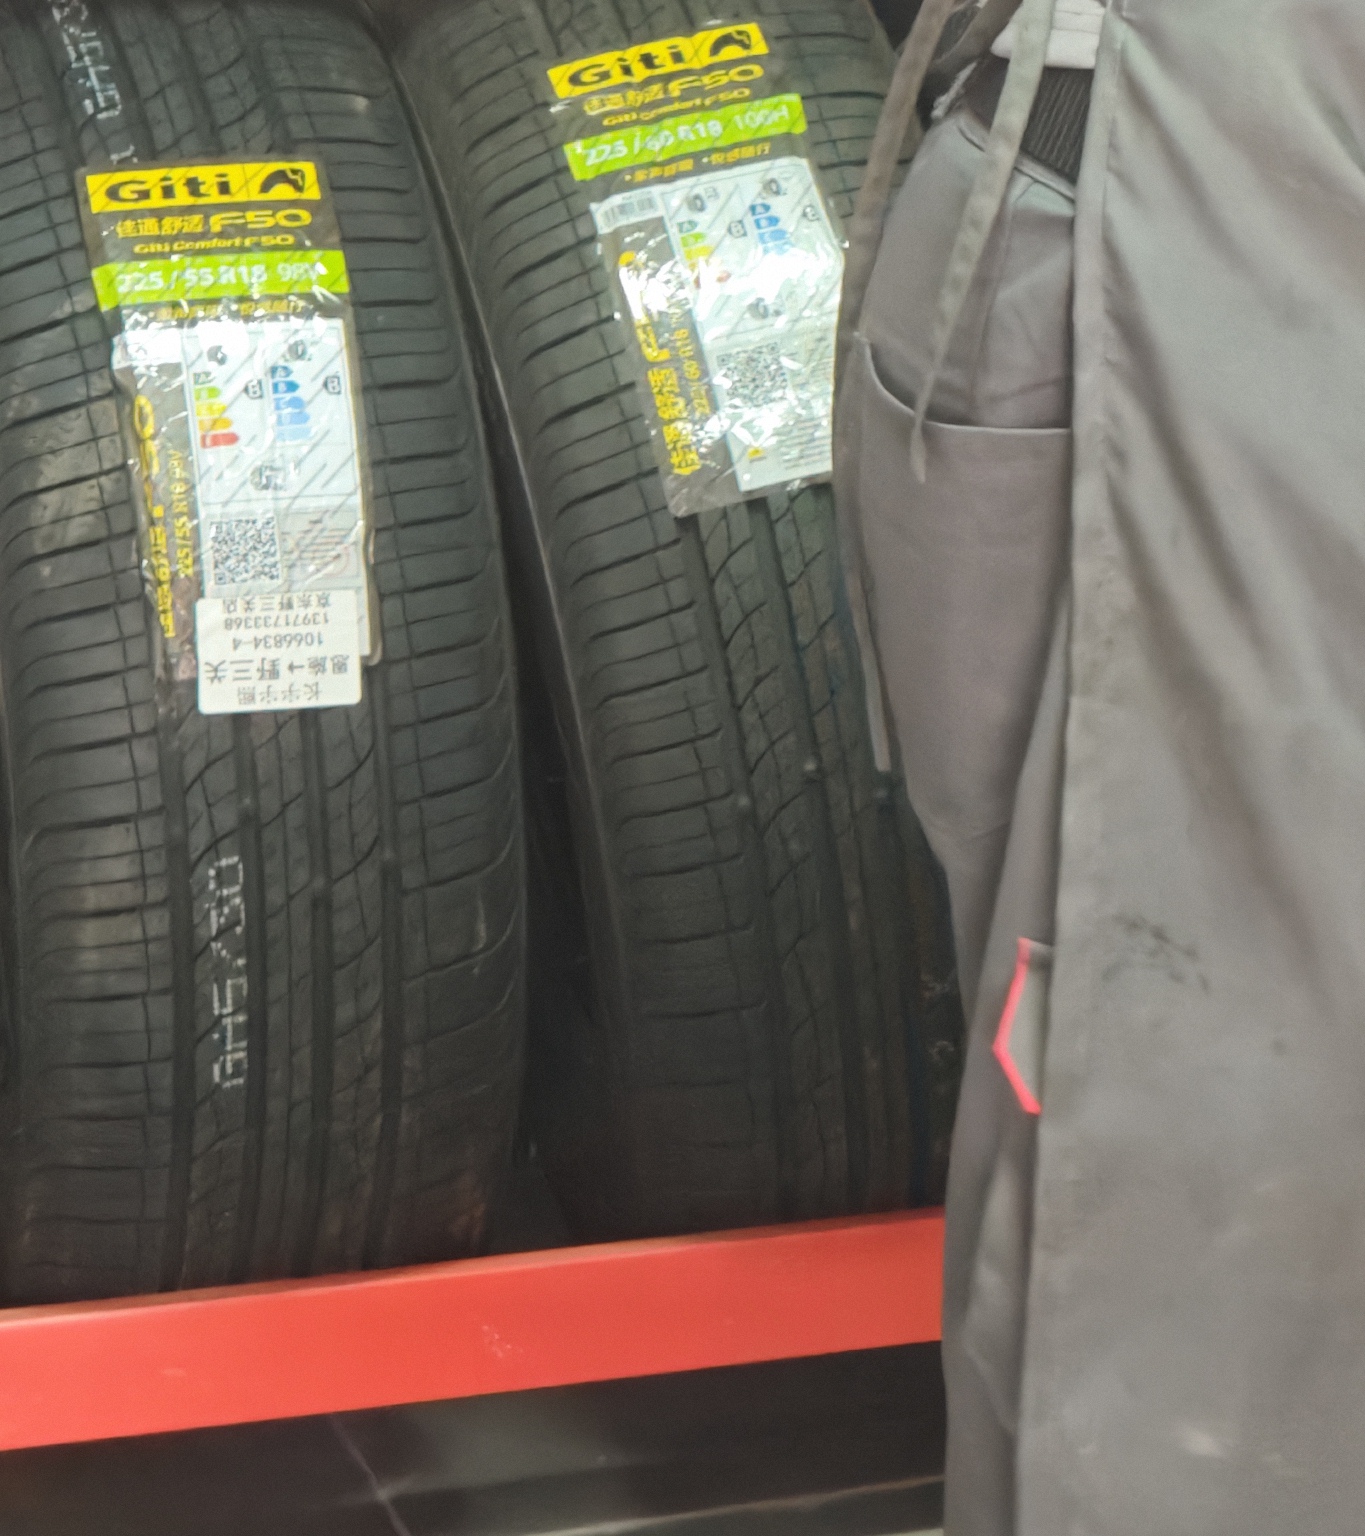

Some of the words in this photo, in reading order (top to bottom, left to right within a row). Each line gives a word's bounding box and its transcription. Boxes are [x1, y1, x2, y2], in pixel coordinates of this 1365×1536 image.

[566, 42, 689, 92] Giti
[103, 168, 232, 205] Giti
[209, 208, 313, 234] F50
[223, 613, 330, 632] 13971733368
[231, 631, 324, 652] 1066834-4
